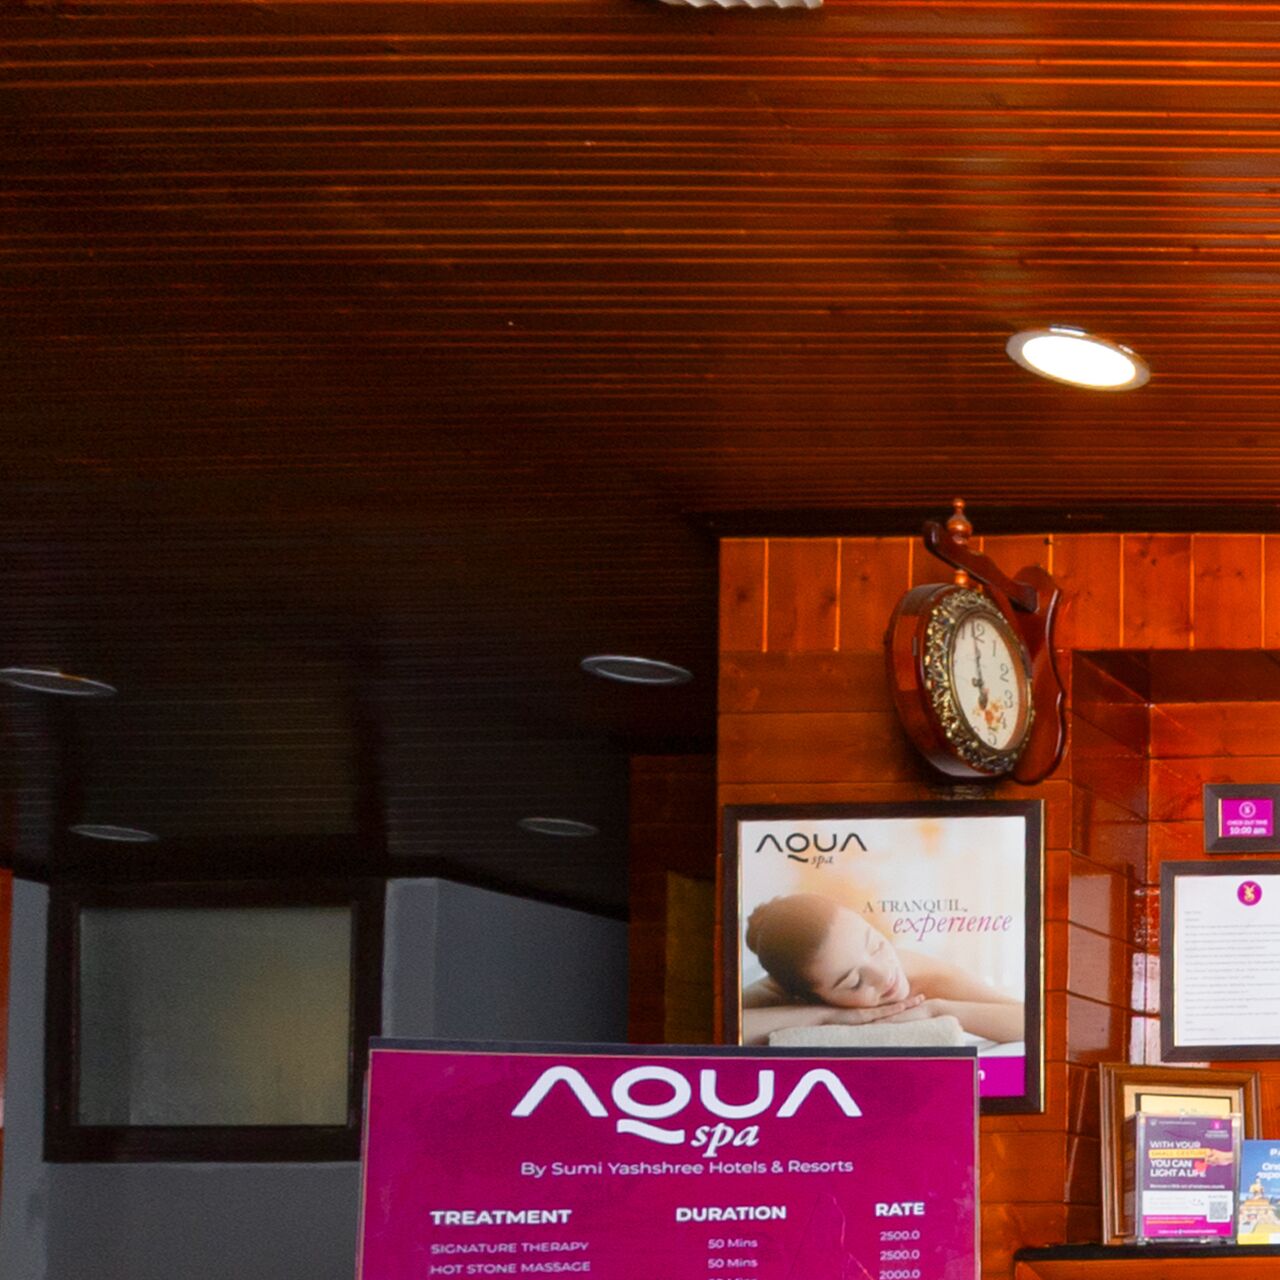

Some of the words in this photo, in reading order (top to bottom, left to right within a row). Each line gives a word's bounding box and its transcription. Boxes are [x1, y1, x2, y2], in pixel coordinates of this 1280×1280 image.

[1000, 663, 1009, 682] 2
[1004, 690, 1014, 709] 3
[756, 833, 867, 863] AQUA
[811, 855, 834, 868] spa
[893, 913, 1013, 941] experience
[511, 1065, 863, 1146] AQUA
[690, 1123, 760, 1158] spa
[1176, 1141, 1201, 1149] YOUR
[521, 1162, 547, 1178] By
[552, 1162, 602, 1176] Sumi
[608, 1161, 704, 1176] Yashshree
[708, 1160, 768, 1175] Hotels
[771, 1160, 784, 1173] &
[788, 1160, 854, 1173] Resorts
[1150, 1159, 1170, 1168] YOU
[1172, 1159, 1192, 1168] CAN
[1150, 1168, 1177, 1177] LIGHT
[675, 1205, 787, 1222] DURATION
[875, 1201, 925, 1217] RATE
[429, 1209, 572, 1226] TREATMENT
[880, 1230, 920, 1241] 2500.0
[431, 1243, 516, 1254] SIGNATURE
[521, 1242, 589, 1252] THERAPY
[708, 1239, 725, 1249] 50
[728, 1239, 758, 1247] Mins
[880, 1249, 920, 1260] 2500.0
[429, 1264, 462, 1275] HOT
[467, 1263, 516, 1274] STONE
[521, 1261, 590, 1272] MASSAGE
[708, 1258, 725, 1268] 50
[727, 1259, 758, 1267] Mins
[880, 1269, 921, 1280] 2000.0
